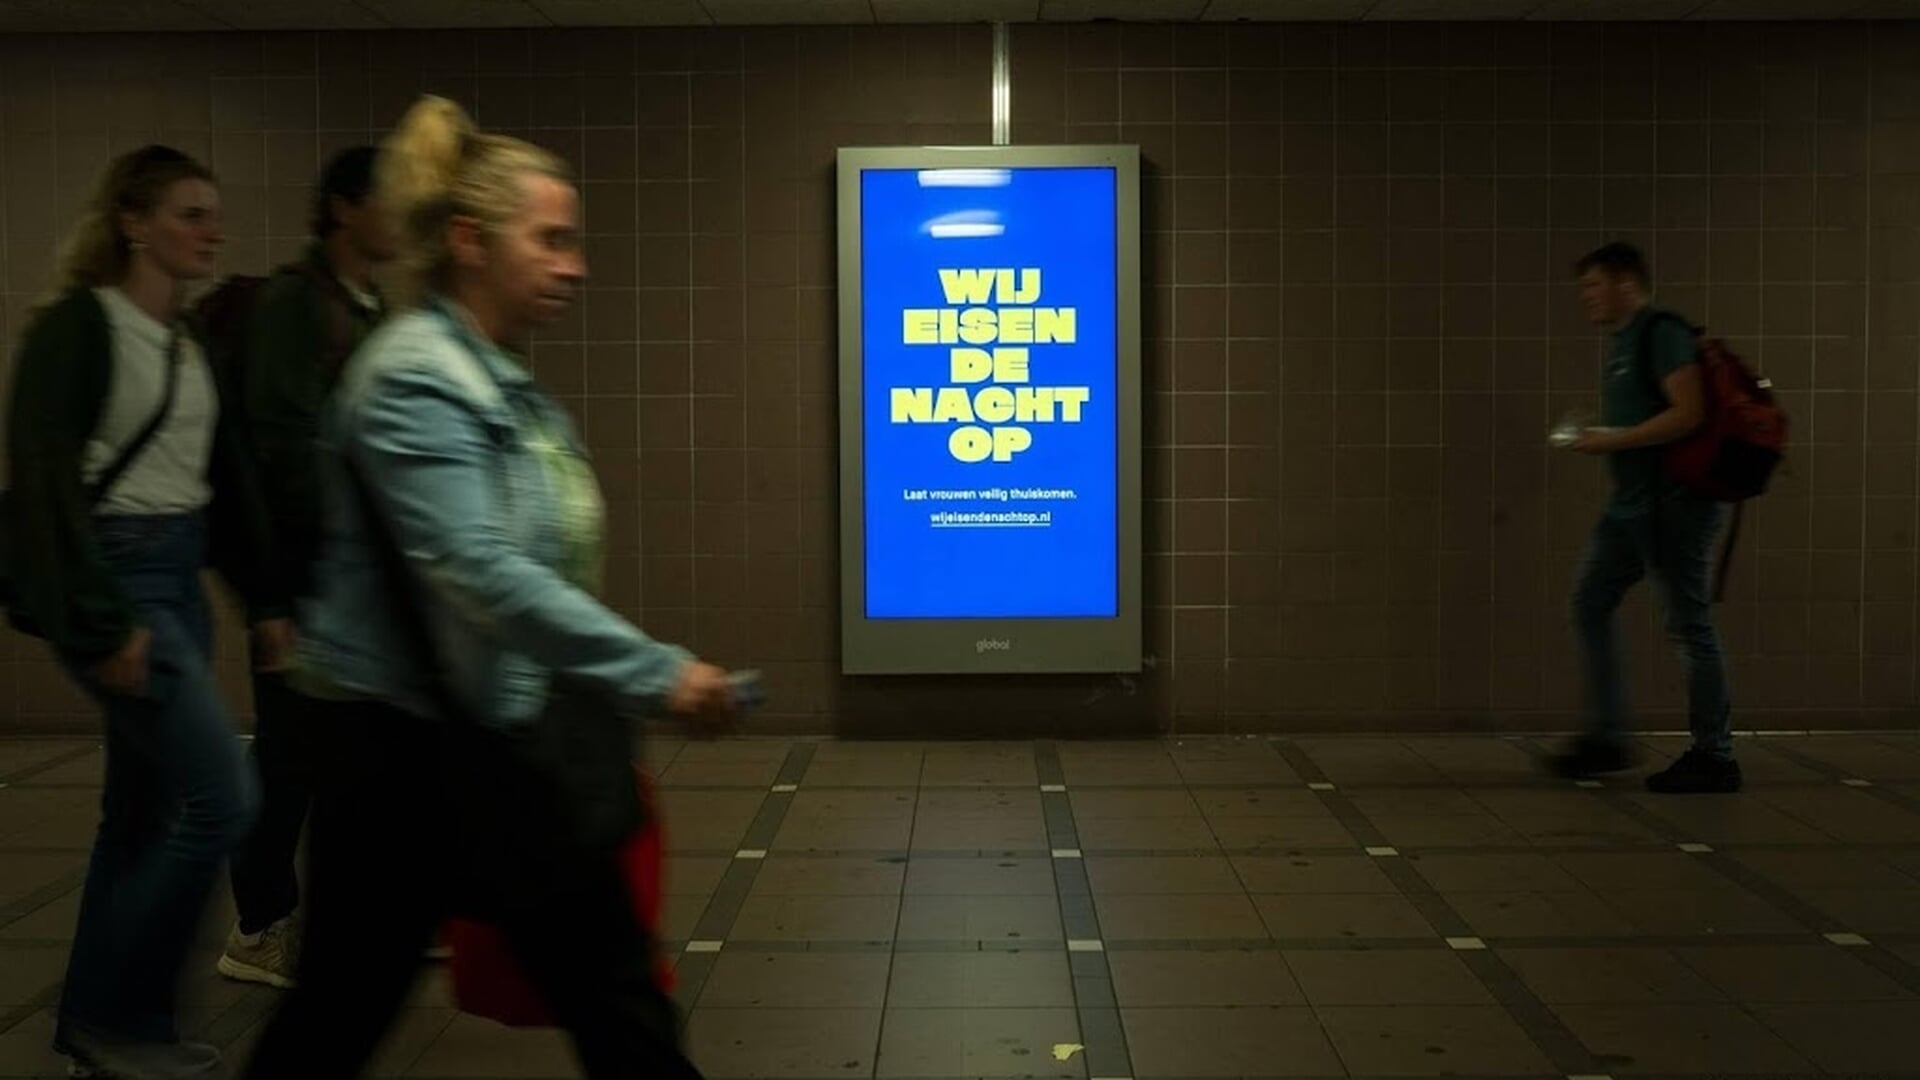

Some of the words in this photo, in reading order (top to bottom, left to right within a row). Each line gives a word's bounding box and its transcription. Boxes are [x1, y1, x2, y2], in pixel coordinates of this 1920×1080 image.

[938, 268, 1041, 304] WIJ
[903, 307, 1076, 344] EISEN
[950, 347, 1029, 383] DE
[890, 386, 1090, 423] NACHT
[948, 425, 1032, 462] OP
[904, 489, 927, 500] Laat
[930, 490, 976, 500] vrouwen
[978, 488, 1008, 501] veilig
[1010, 488, 1076, 499] thuiskomen.
[931, 511, 1051, 525] wijeisendenachtop.nl
[976, 638, 1010, 653] global
